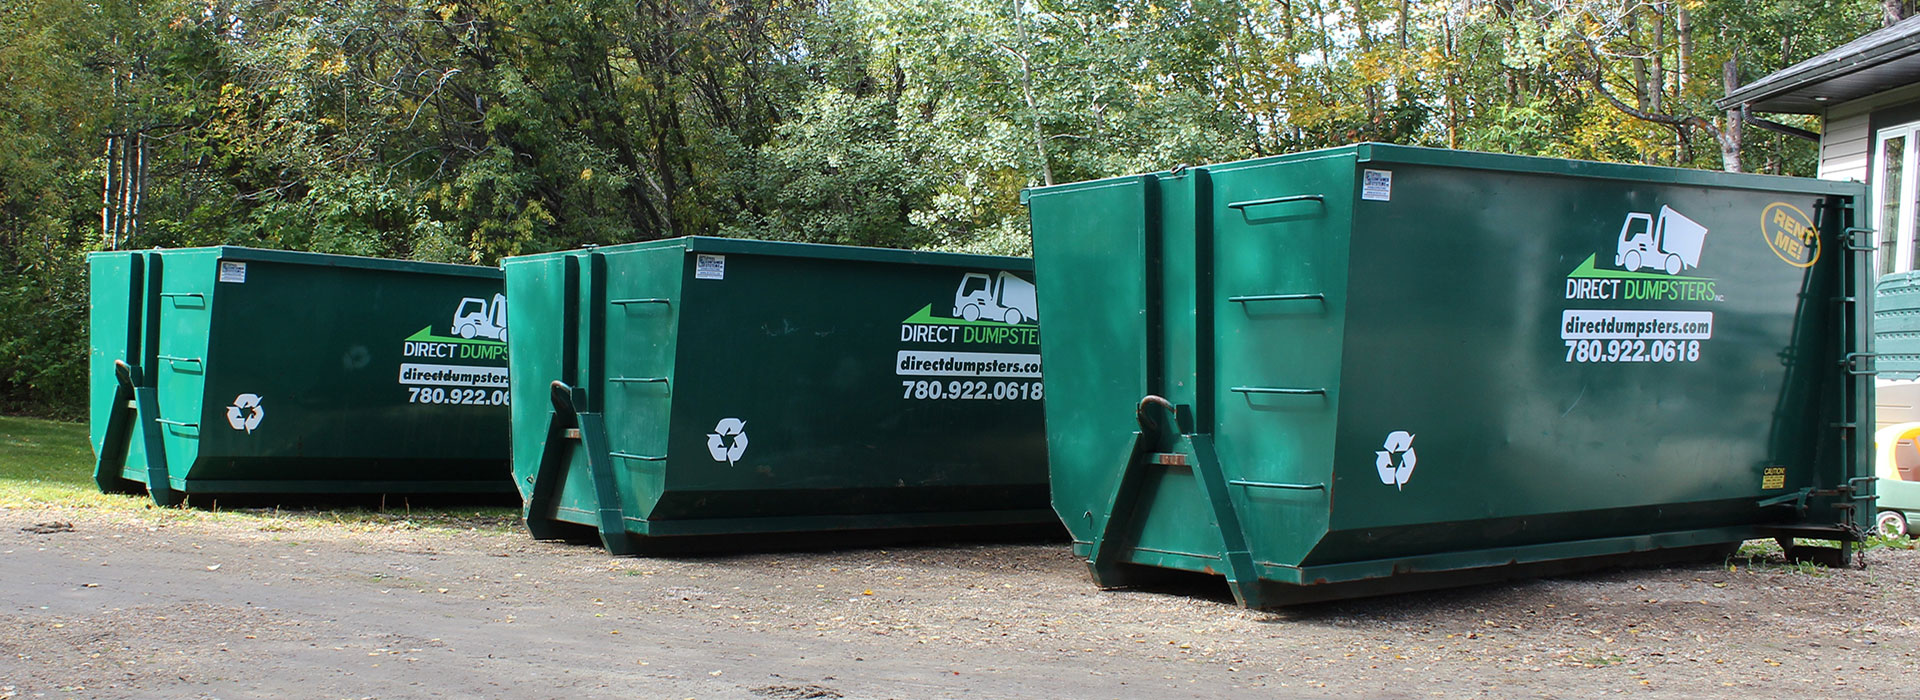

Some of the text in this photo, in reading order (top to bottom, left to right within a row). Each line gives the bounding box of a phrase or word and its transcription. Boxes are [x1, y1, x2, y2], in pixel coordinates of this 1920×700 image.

[1773, 208, 1814, 246] RENT
[1774, 230, 1804, 260] ME!
[1565, 279, 1621, 300] DIRECT
[1624, 280, 1716, 301] DUMPSTERS
[900, 324, 1040, 345] DIRECT DUMPSTE
[1565, 315, 1709, 338] directdumpsters.com
[403, 341, 458, 358] DIRECT
[1565, 339, 1700, 363] 780.922.0618
[900, 355, 1042, 375] directdumpsters.co
[902, 380, 1043, 400] 780.922.0618
